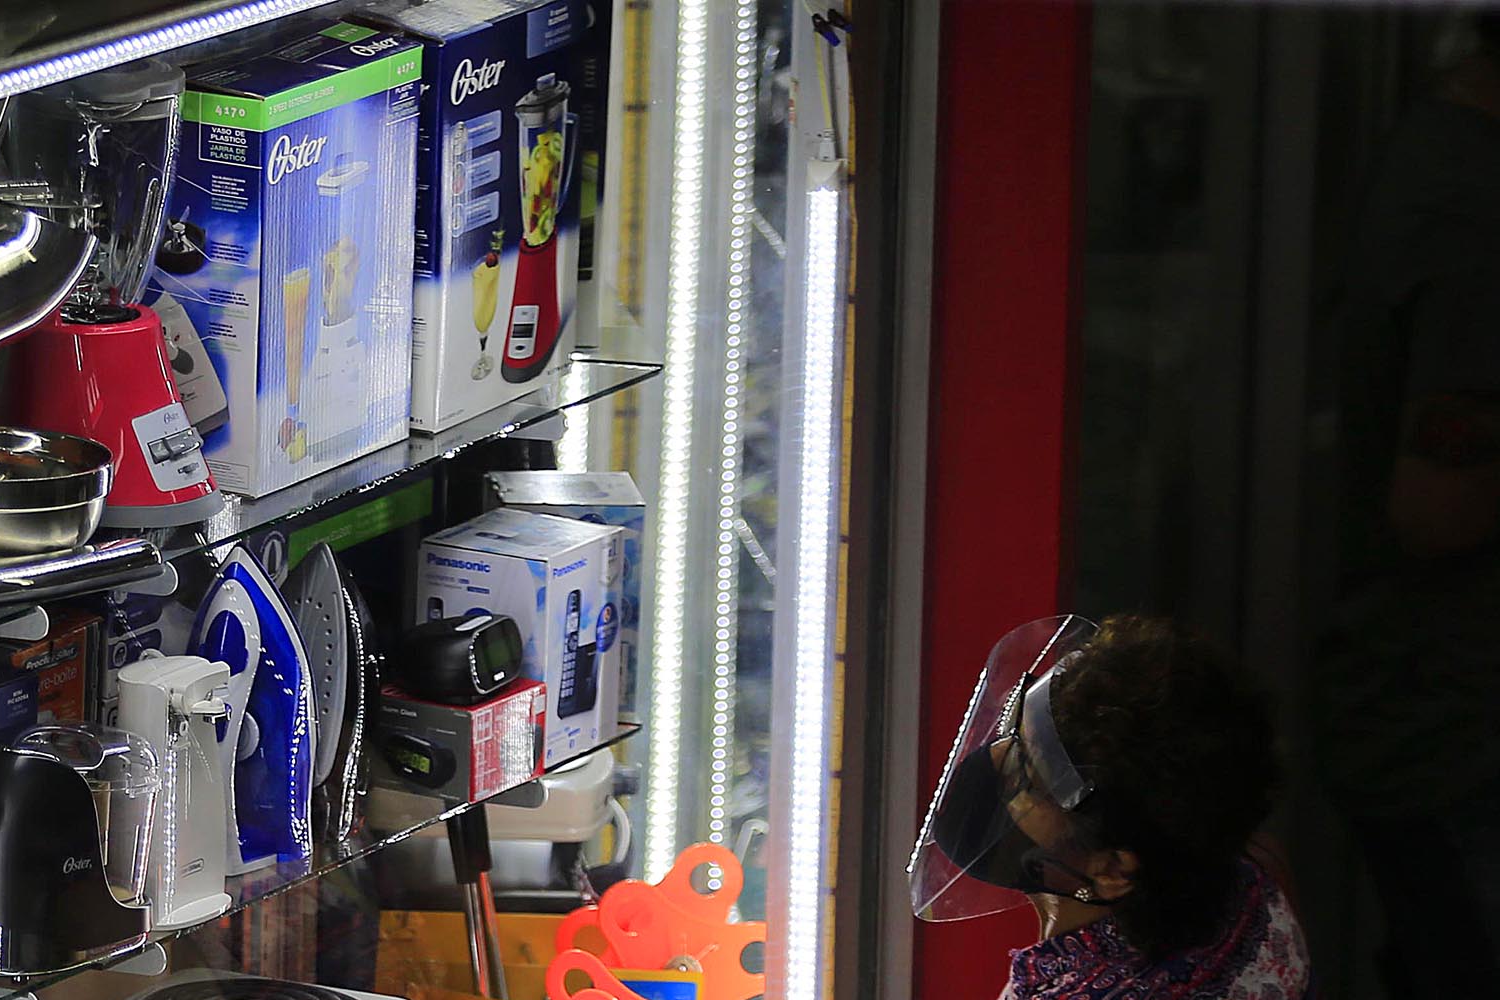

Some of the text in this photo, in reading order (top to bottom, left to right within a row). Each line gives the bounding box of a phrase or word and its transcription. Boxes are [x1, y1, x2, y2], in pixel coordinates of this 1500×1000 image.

[350, 36, 399, 57] Oster
[451, 58, 506, 106] Oster
[215, 105, 246, 118] 4170
[211, 126, 232, 136] VASO
[210, 144, 246, 156] JARRA DE
[266, 134, 328, 185] Oster
[427, 552, 492, 573] Panasonic
[553, 557, 588, 578] Panasonic
[63, 857, 92, 874] Oster
